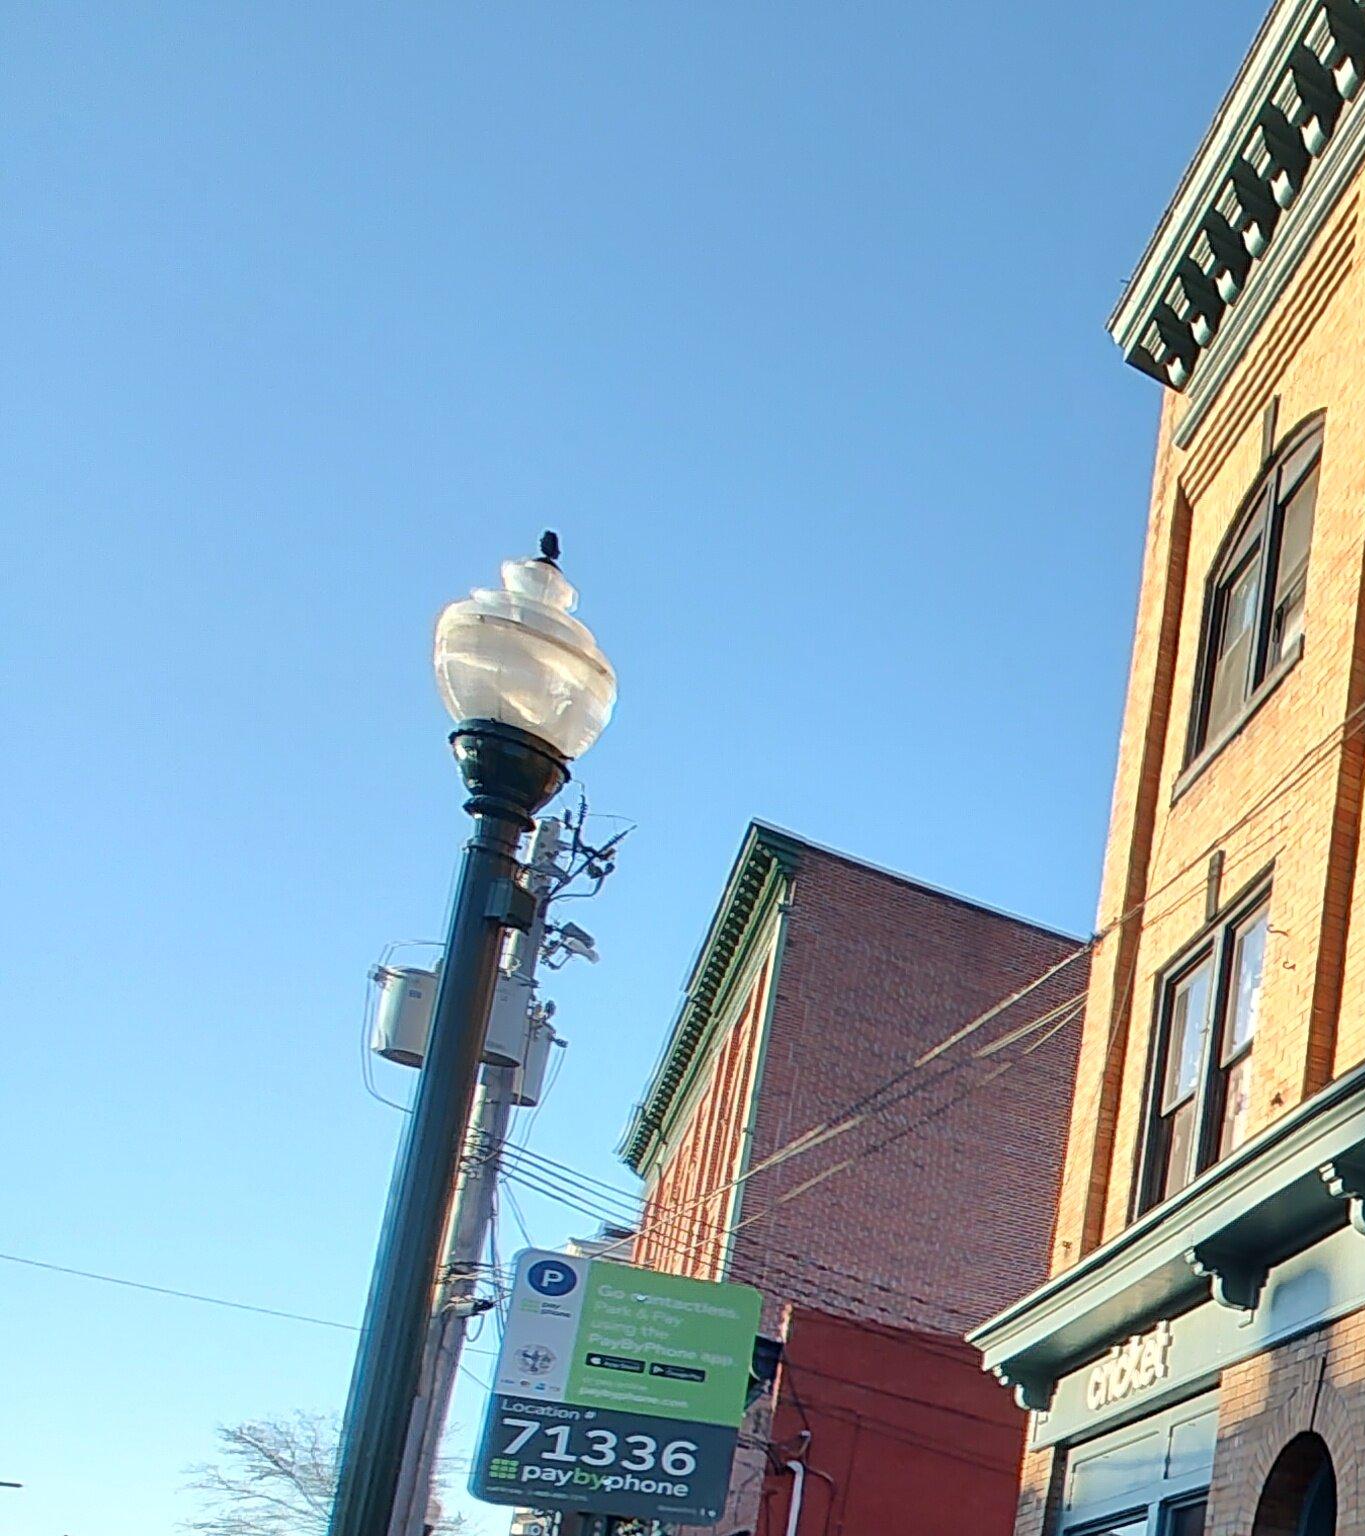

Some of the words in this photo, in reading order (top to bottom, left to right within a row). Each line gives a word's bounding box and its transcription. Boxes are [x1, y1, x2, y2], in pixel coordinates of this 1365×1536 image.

[541, 1269, 565, 1288] P
[653, 1310, 684, 1328] Pay
[588, 1333, 698, 1361] PayByPhone
[501, 1398, 580, 1420] Location
[583, 1409, 597, 1420] #
[501, 1417, 699, 1477] 71336
[520, 1464, 690, 1498] paybyphone
